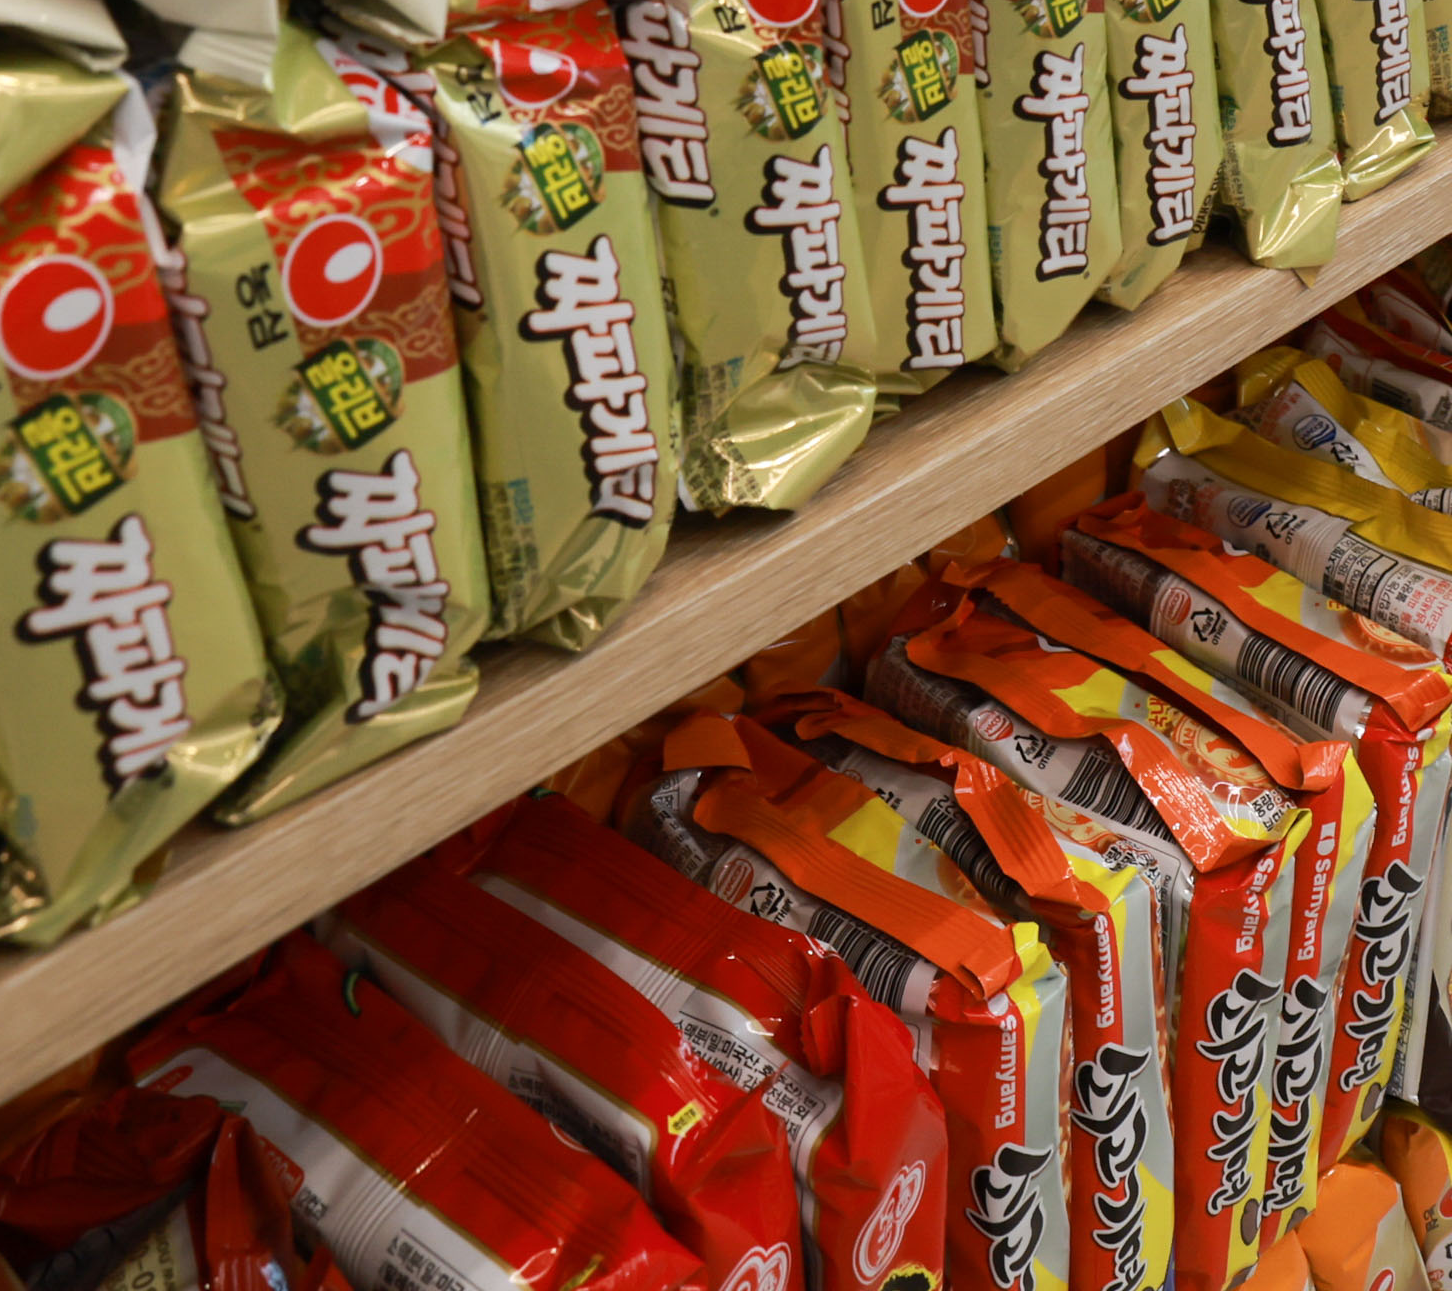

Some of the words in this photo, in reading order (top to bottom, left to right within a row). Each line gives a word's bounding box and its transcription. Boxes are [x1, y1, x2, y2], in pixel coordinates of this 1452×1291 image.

[525, 134, 588, 222] 올리브
[764, 48, 819, 131] 올리브
[903, 37, 945, 117] 올리브
[1015, 43, 1091, 282] 짜파게티
[1122, 24, 1197, 247] 짜파게티
[879, 126, 965, 373] 짜파게티
[22, 400, 114, 507] 올리브
[307, 351, 387, 440] 올리브
[520, 234, 658, 529] 짜파게티
[20, 516, 192, 801] 짜파게
[1211, 619, 1229, 646] OTHER
[1038, 745, 1057, 769] OTHER
[1341, 860, 1425, 1092] 쇠고기면
[1196, 969, 1281, 1215] 쇠고기면
[1261, 976, 1328, 1217] 쇠고기면
